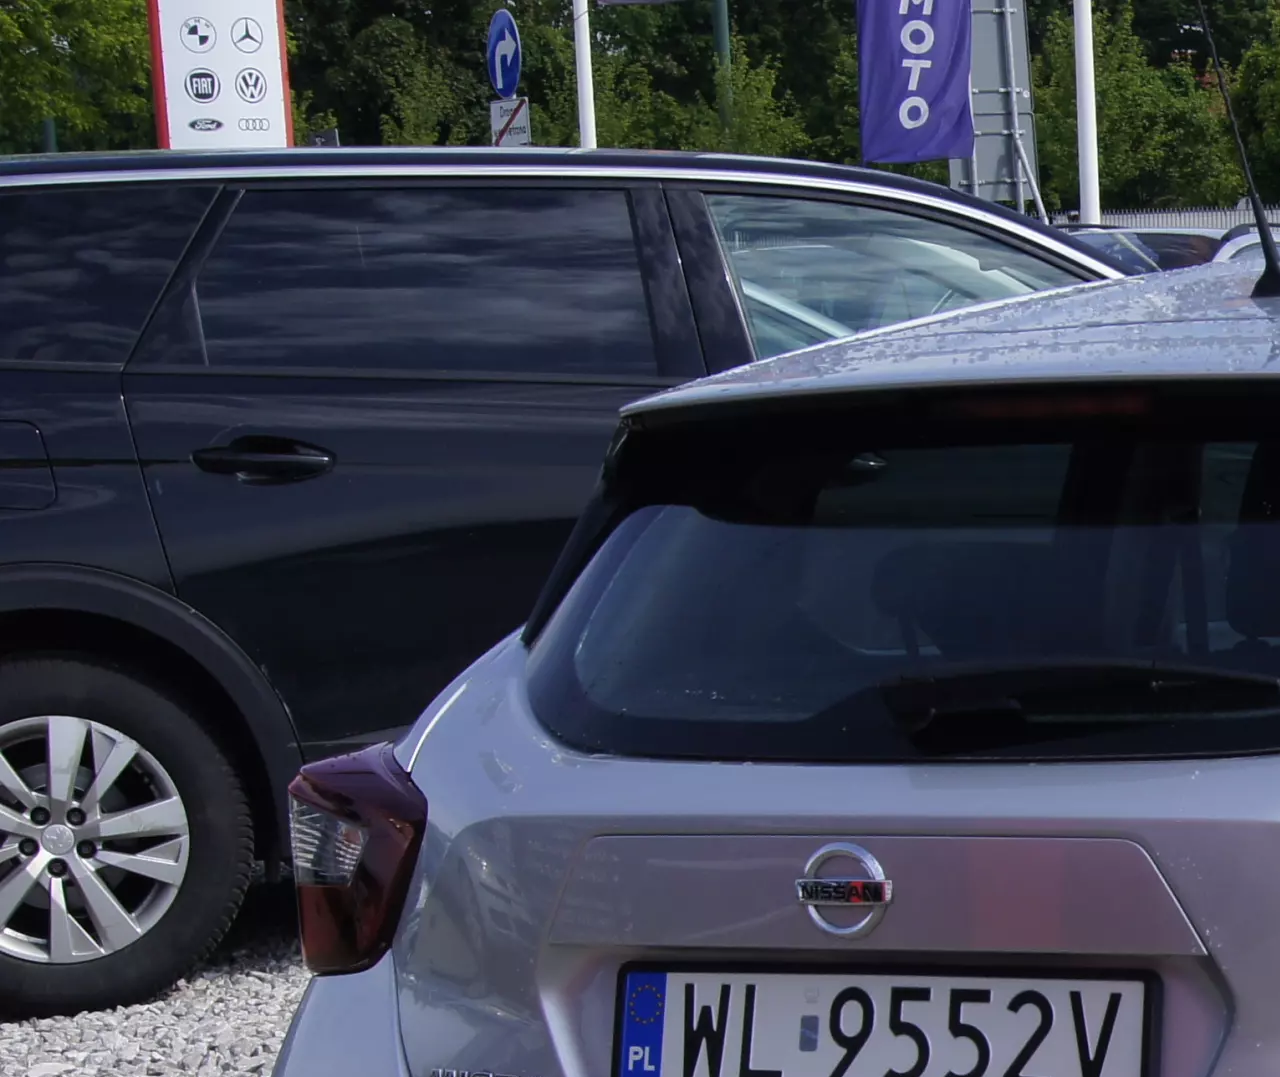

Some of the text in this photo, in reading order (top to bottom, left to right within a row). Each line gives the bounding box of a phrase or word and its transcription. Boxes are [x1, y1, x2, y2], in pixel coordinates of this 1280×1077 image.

[191, 77, 213, 95] FIAT
[801, 885, 884, 902] NISSAN
[627, 1046, 656, 1072] PL
